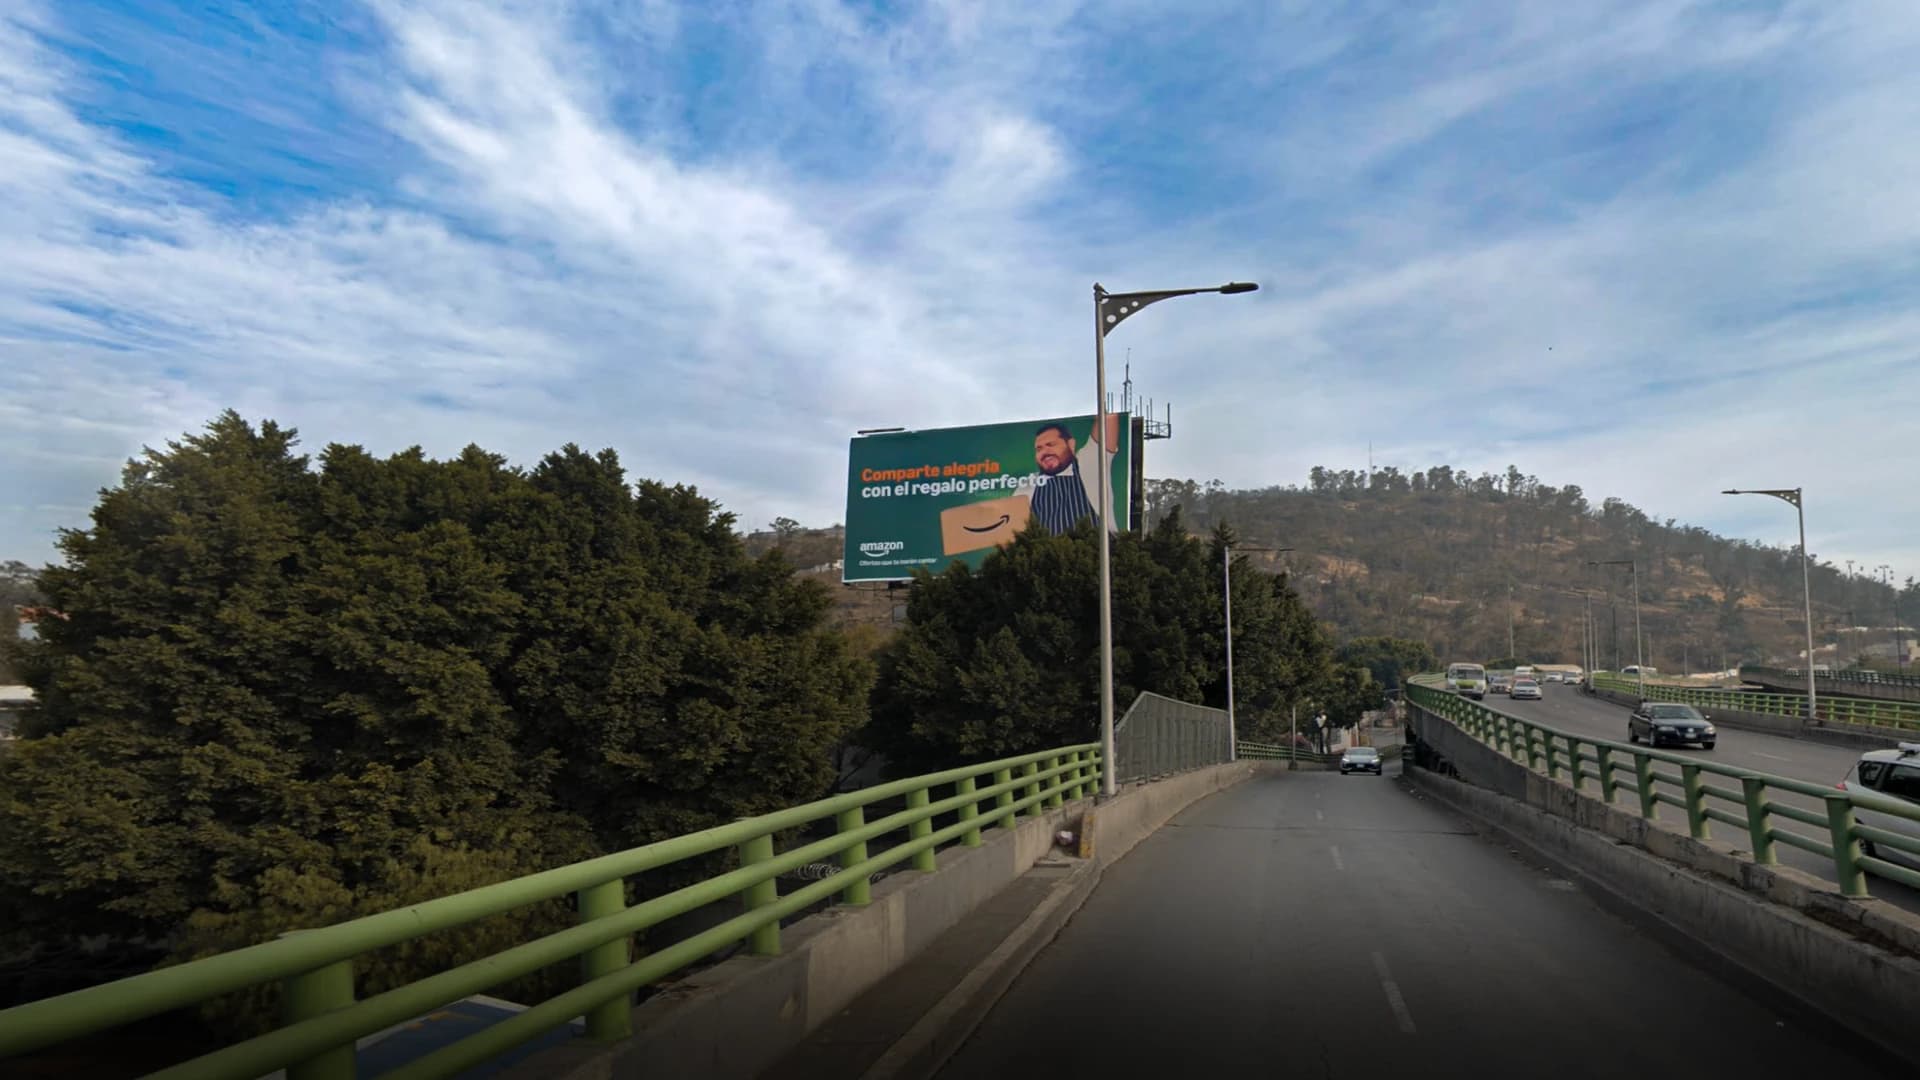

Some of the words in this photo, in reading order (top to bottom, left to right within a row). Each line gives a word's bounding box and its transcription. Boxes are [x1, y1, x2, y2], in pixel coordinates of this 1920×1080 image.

[861, 466, 940, 482] Comparte
[861, 486, 892, 498] con
[894, 481, 909, 496] el
[911, 478, 966, 497] regalo
[968, 473, 1048, 494] perfecto
[860, 541, 904, 552] amazon
